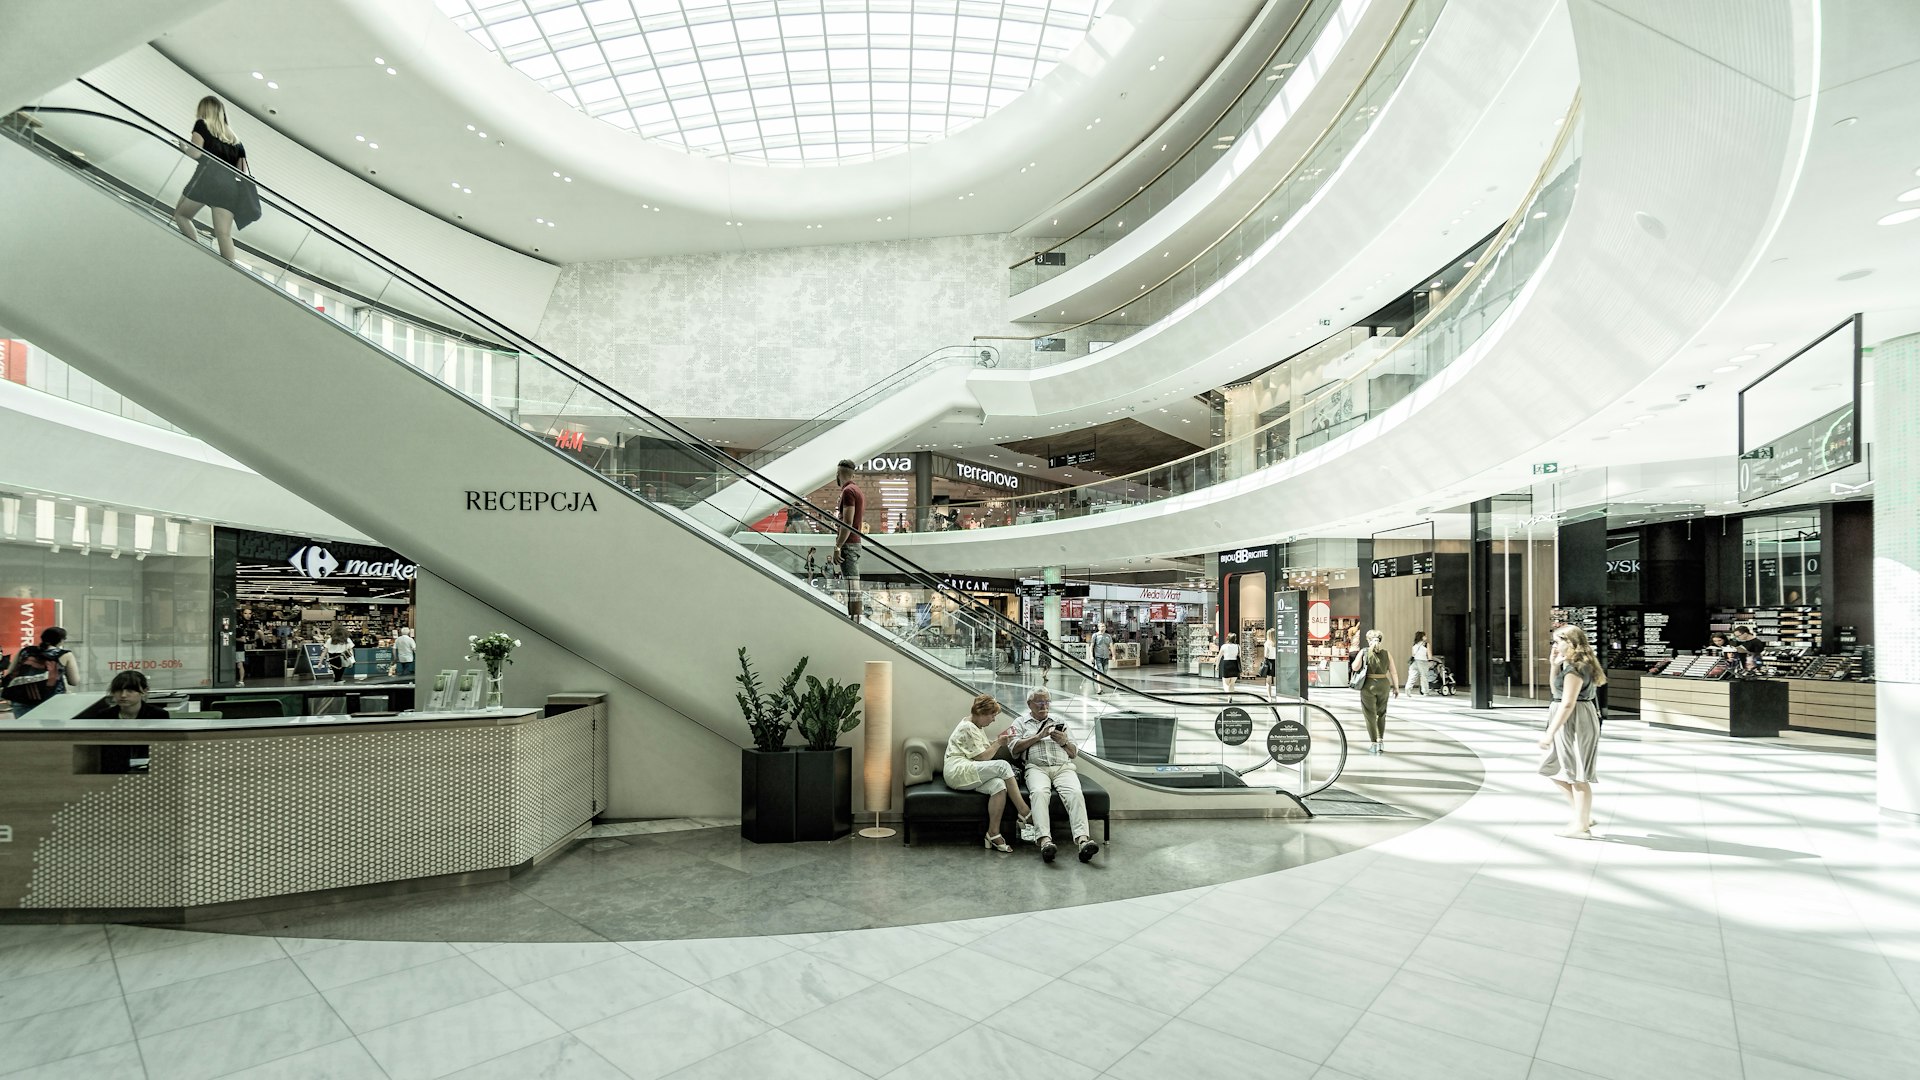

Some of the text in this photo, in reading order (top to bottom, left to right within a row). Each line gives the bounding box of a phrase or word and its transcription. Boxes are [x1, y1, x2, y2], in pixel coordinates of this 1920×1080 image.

[854, 457, 912, 471] nova
[464, 490, 598, 512] RECEPCJA
[1220, 554, 1236, 563] BIJOU
[1311, 616, 1328, 624] SALE
[108, 659, 183, 671] TERAZ DO -50%
